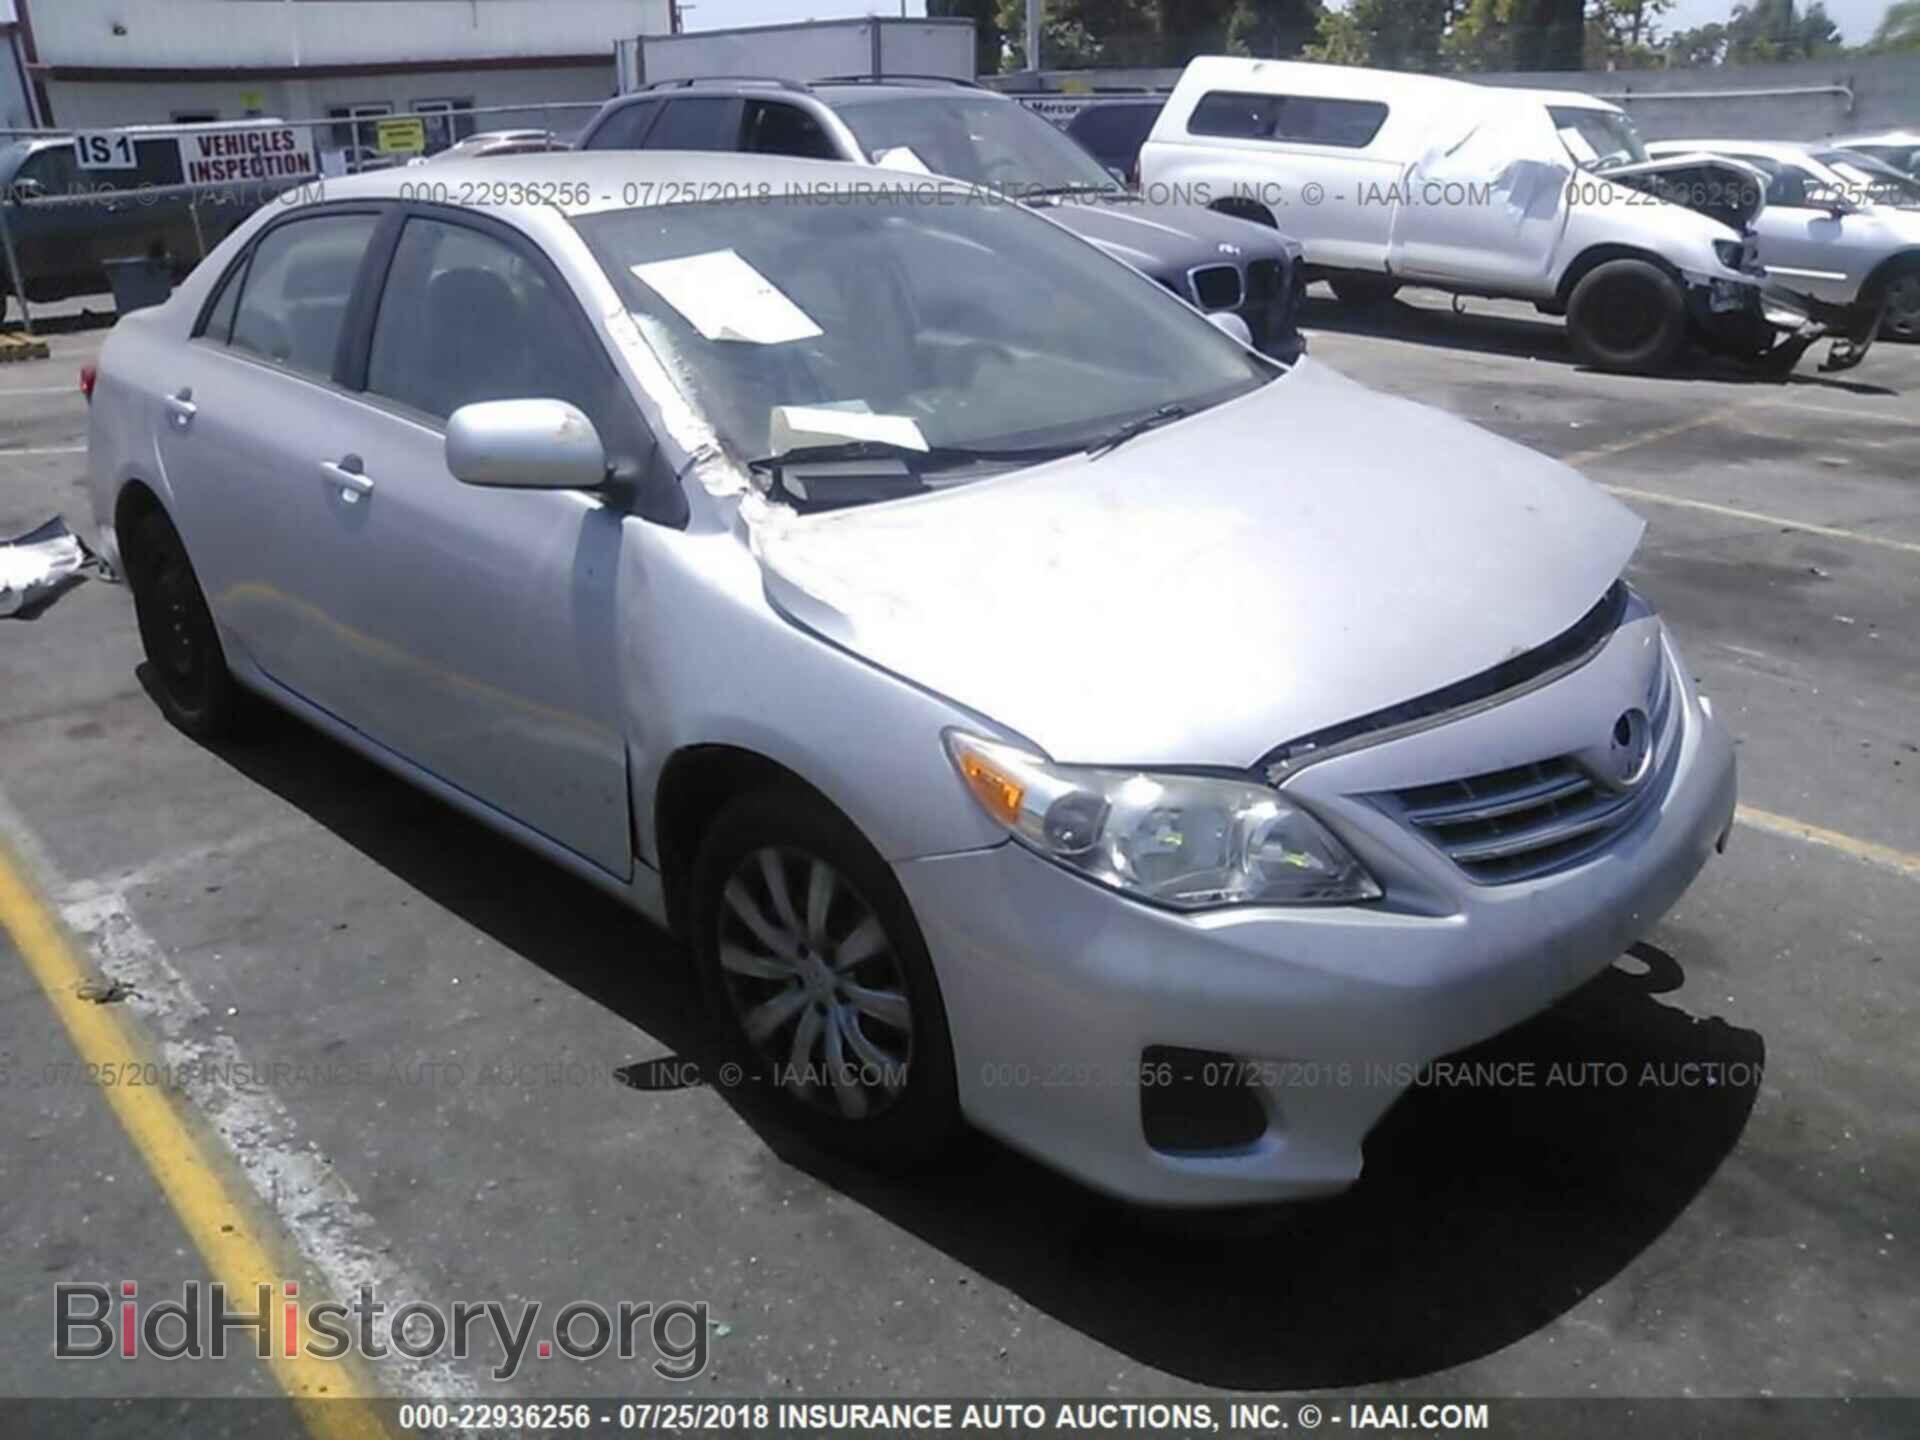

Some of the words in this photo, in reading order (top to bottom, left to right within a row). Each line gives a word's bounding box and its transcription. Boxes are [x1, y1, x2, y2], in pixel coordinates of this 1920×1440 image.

[1032, 101, 1077, 114] Mercur
[197, 130, 295, 157] VEHICLES
[189, 152, 311, 184] INSPECTION
